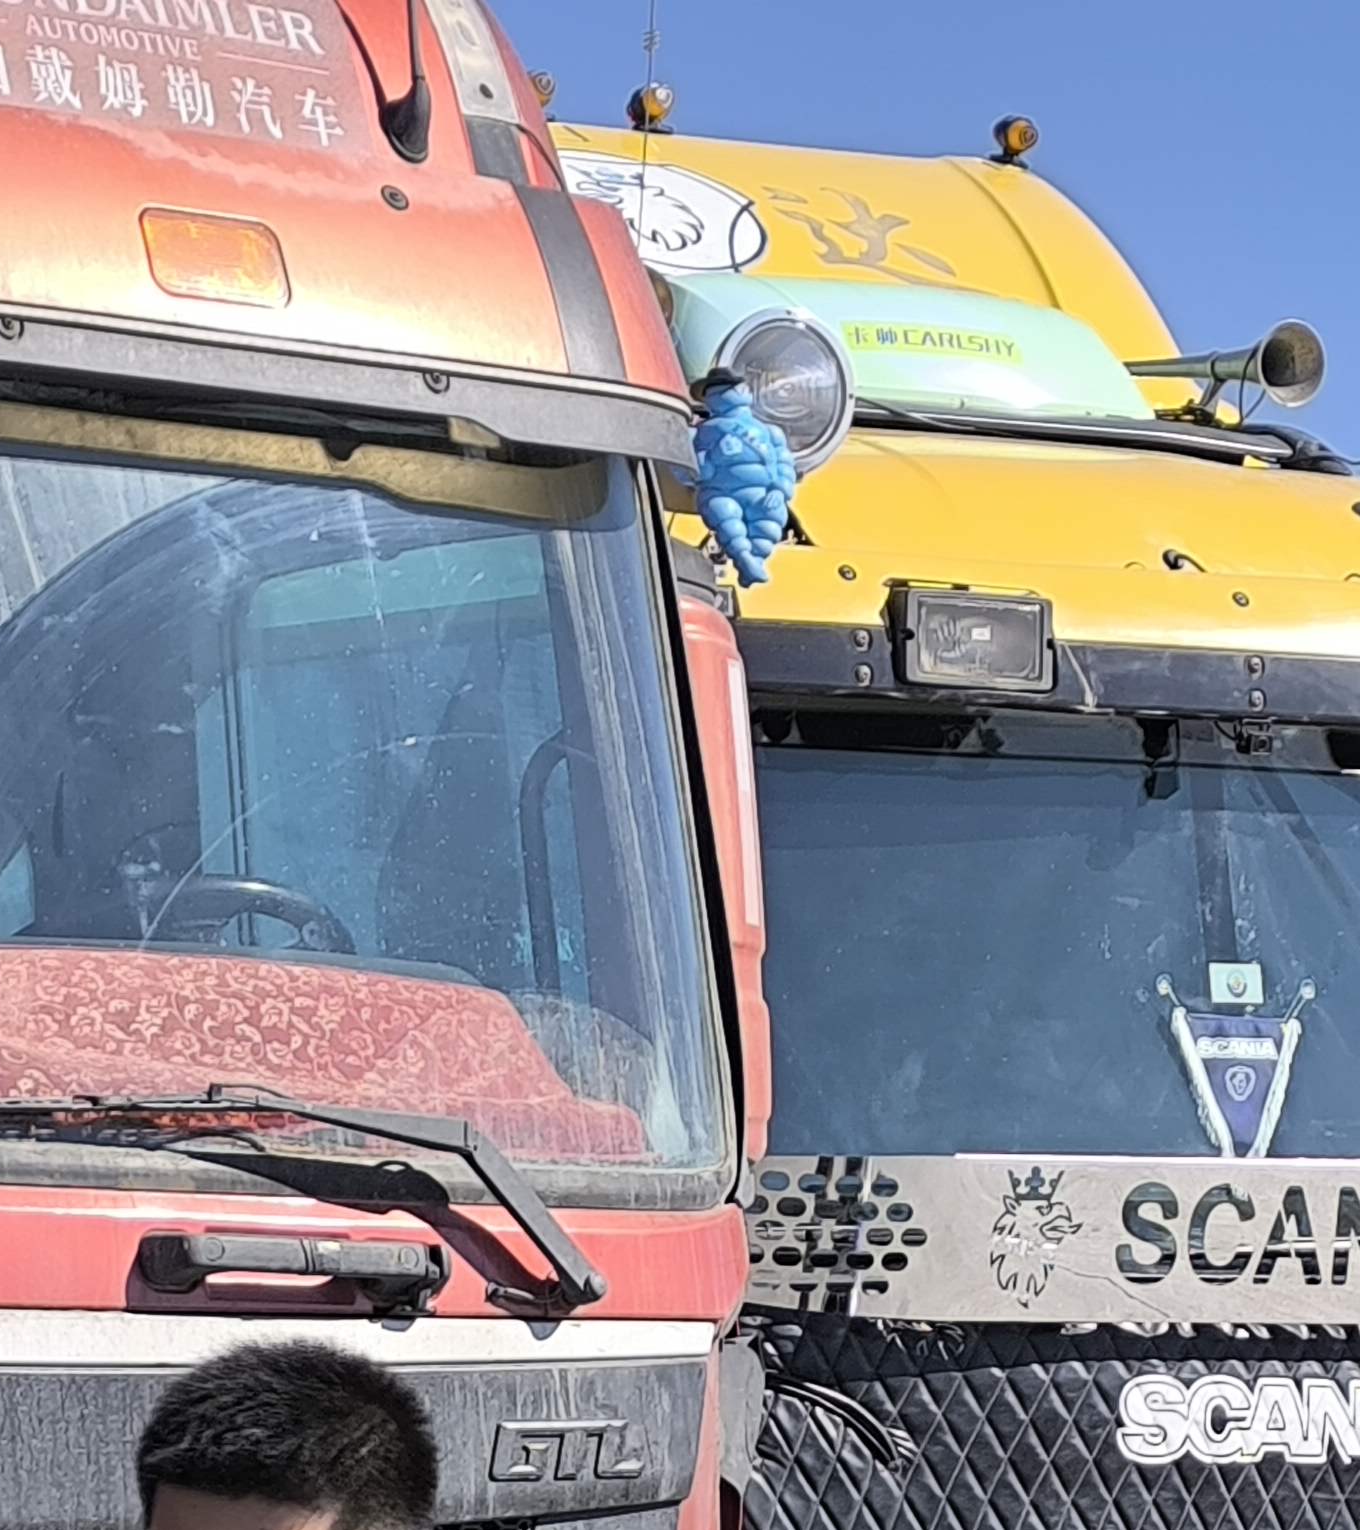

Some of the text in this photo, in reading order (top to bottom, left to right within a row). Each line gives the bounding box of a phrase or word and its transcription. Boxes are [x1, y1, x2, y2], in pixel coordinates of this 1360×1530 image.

[26, 14, 201, 60] AUTOMOTIVE
[1197, 1036, 1279, 1060] SCANIA
[489, 1419, 644, 1482] GTL
